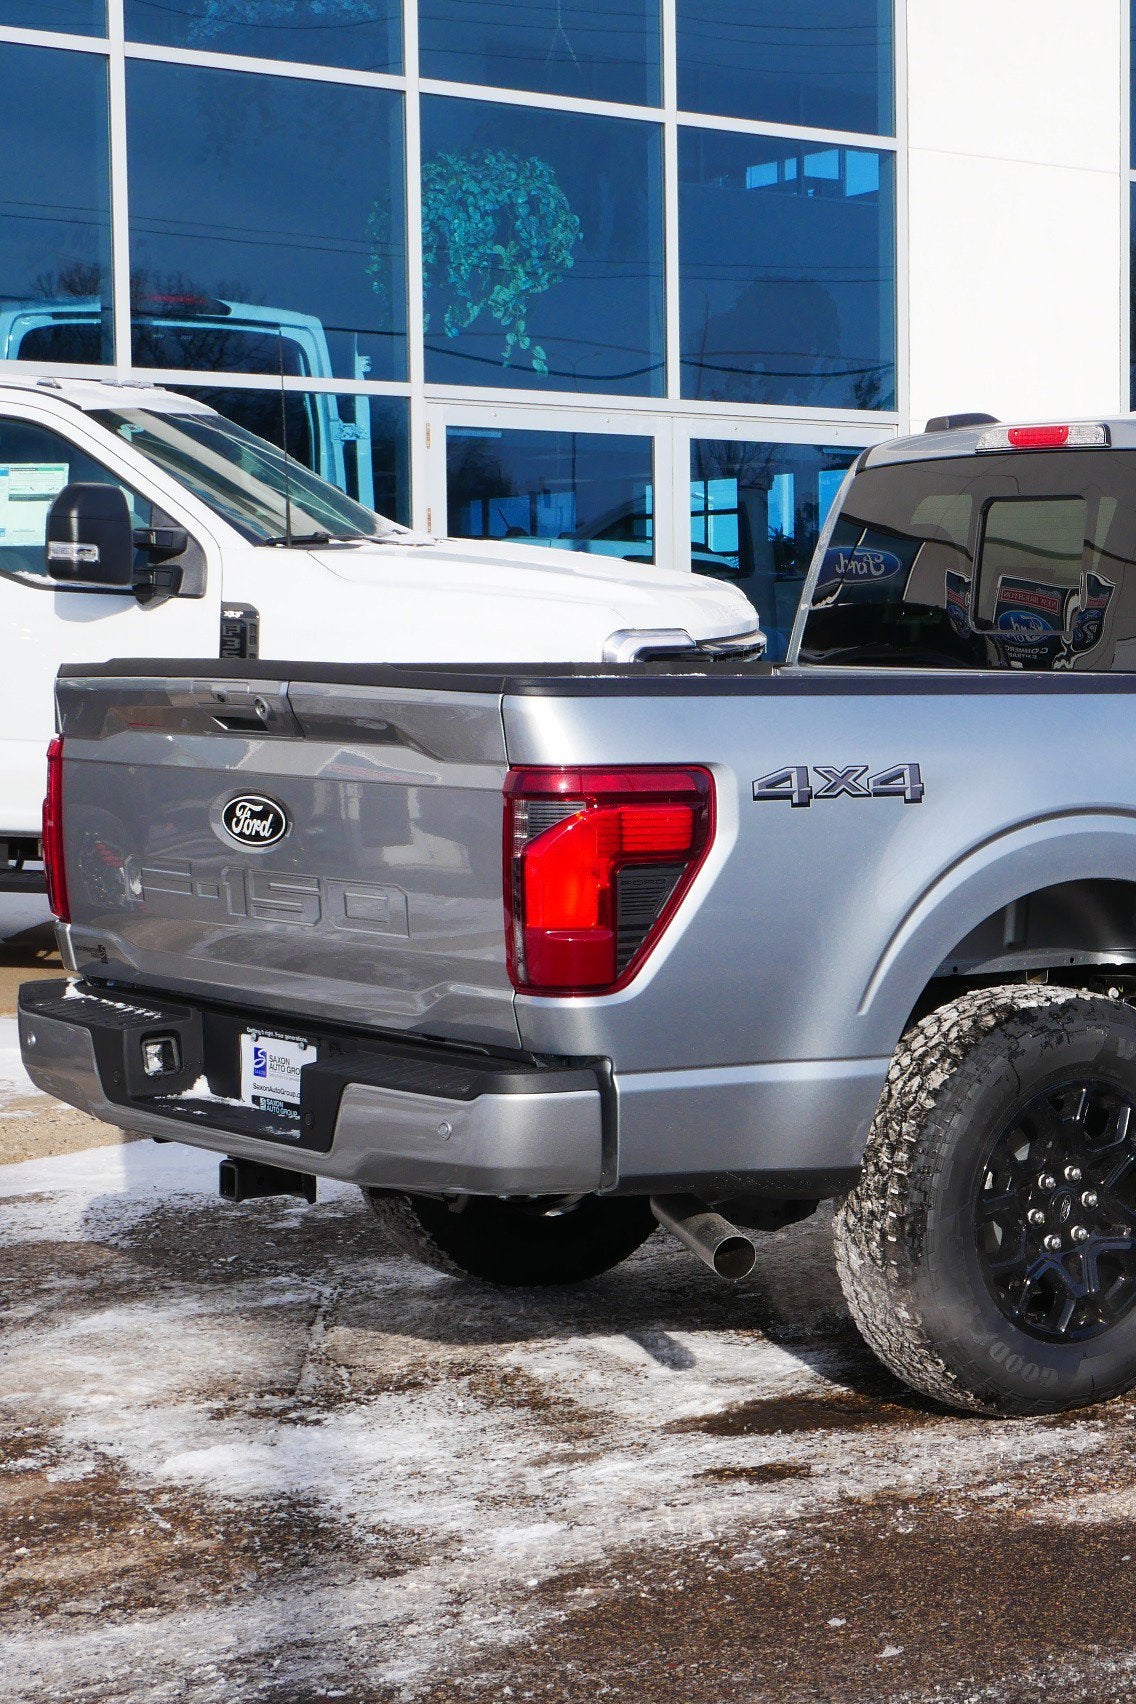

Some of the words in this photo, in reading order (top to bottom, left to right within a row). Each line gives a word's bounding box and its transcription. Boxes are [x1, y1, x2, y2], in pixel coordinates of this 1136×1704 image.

[752, 763, 924, 808] 4X4
[231, 801, 274, 838] Ford
[123, 854, 410, 938] F-150
[269, 1054, 290, 1065] SAXON
[269, 1063, 285, 1073] AUTO
[266, 1098, 284, 1107] SAXON
[266, 1105, 280, 1114] AUTO
